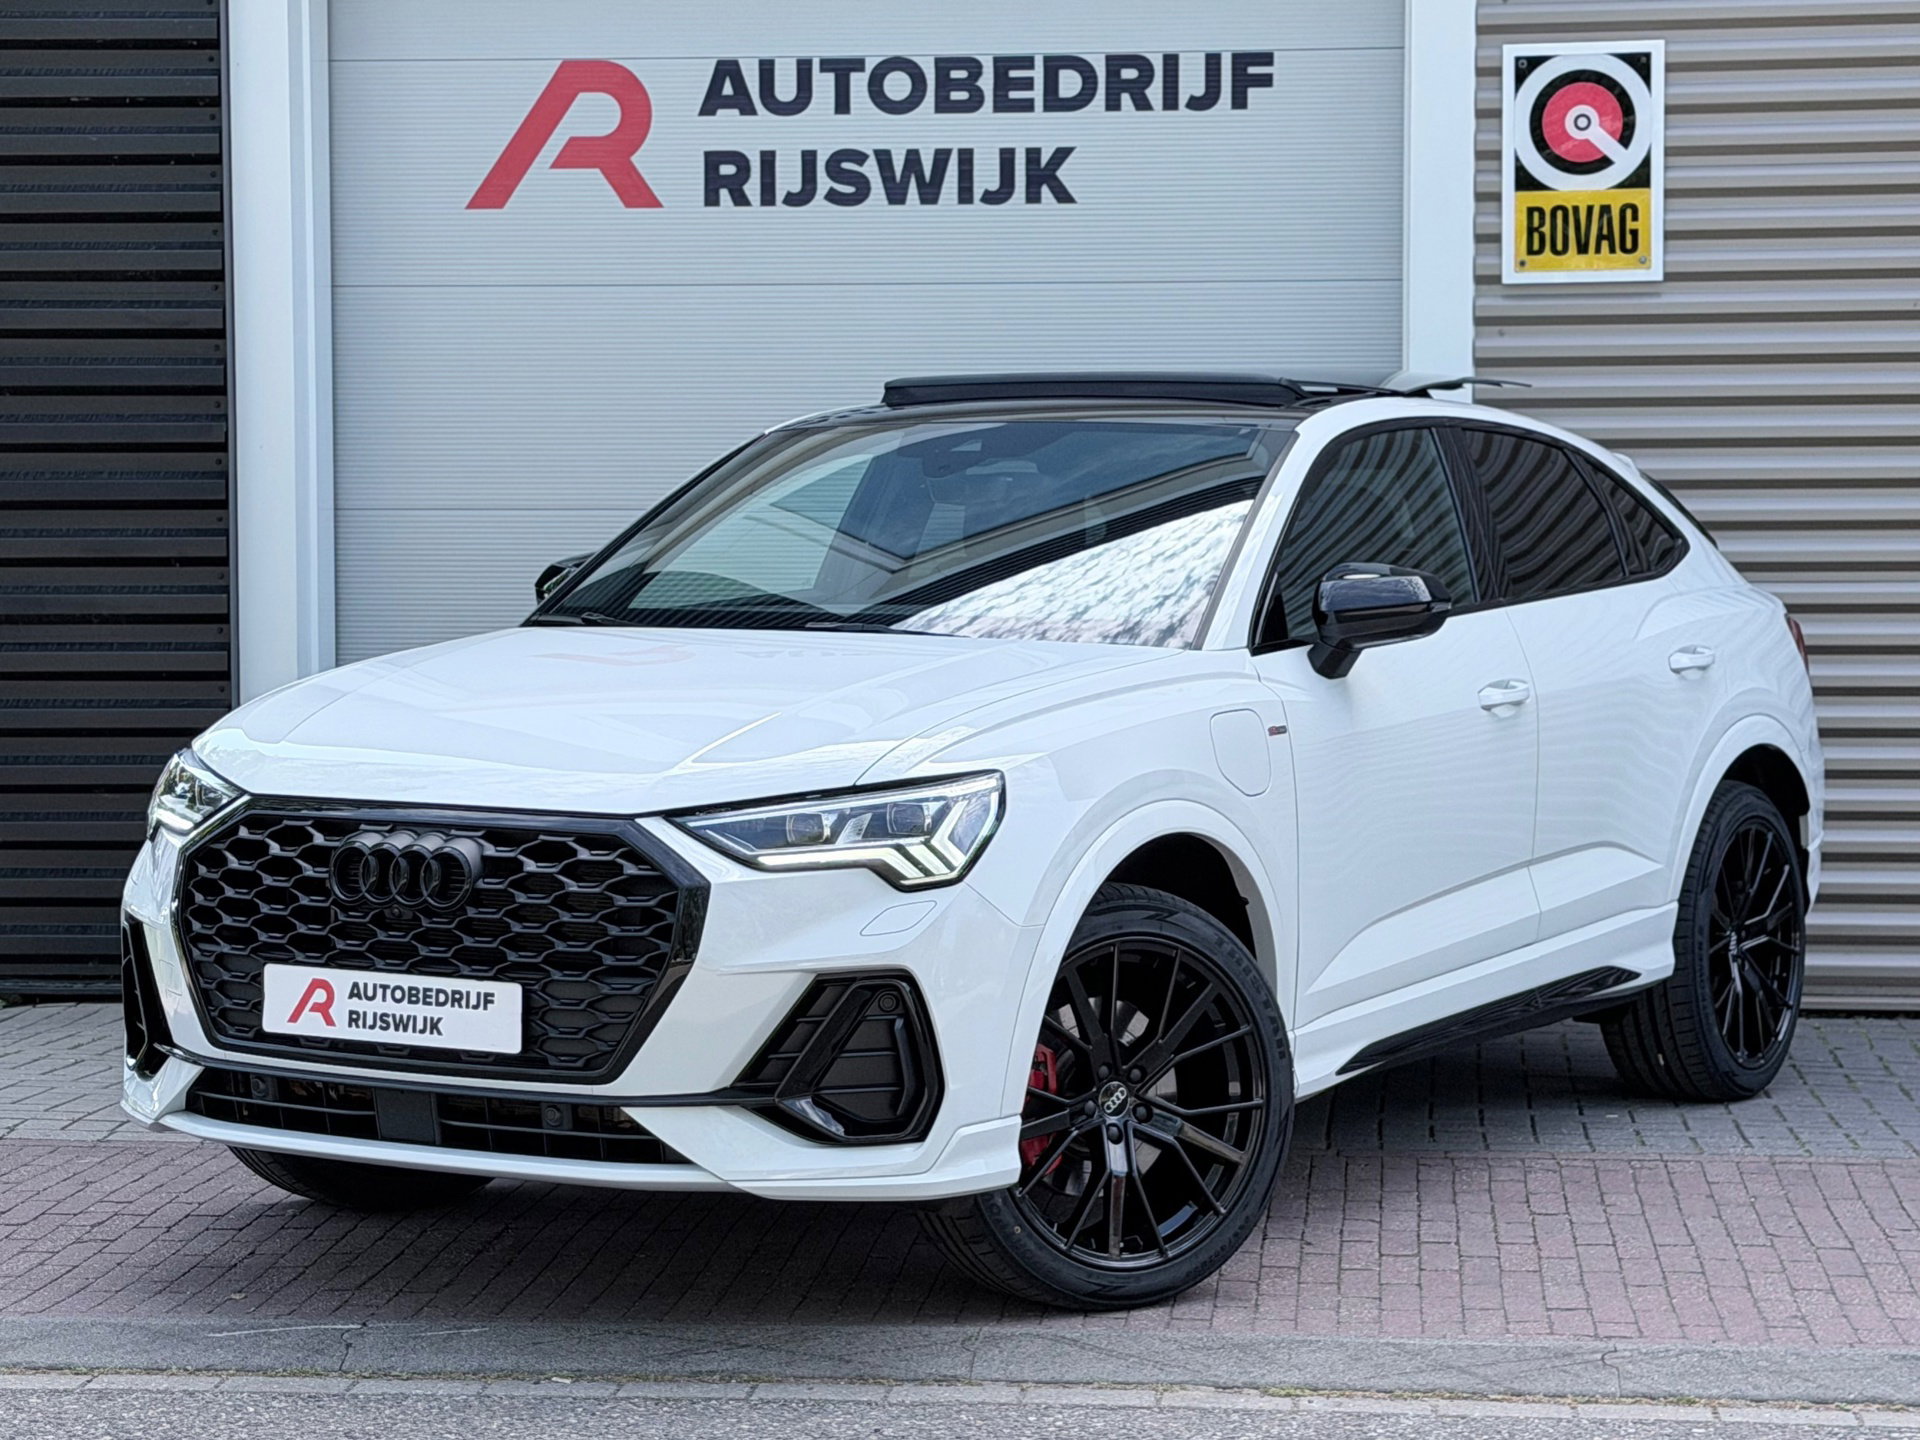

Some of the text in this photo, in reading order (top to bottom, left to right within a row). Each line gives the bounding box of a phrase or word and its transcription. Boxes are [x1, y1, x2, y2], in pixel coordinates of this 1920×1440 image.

[698, 51, 1275, 116] AUTOBEDRIJF
[703, 146, 1077, 207] RIJSWIJK
[1525, 203, 1639, 257] BOVAG
[347, 981, 495, 1011] AUTOBEDRIJF
[347, 1010, 443, 1036] RIJSWIJK
